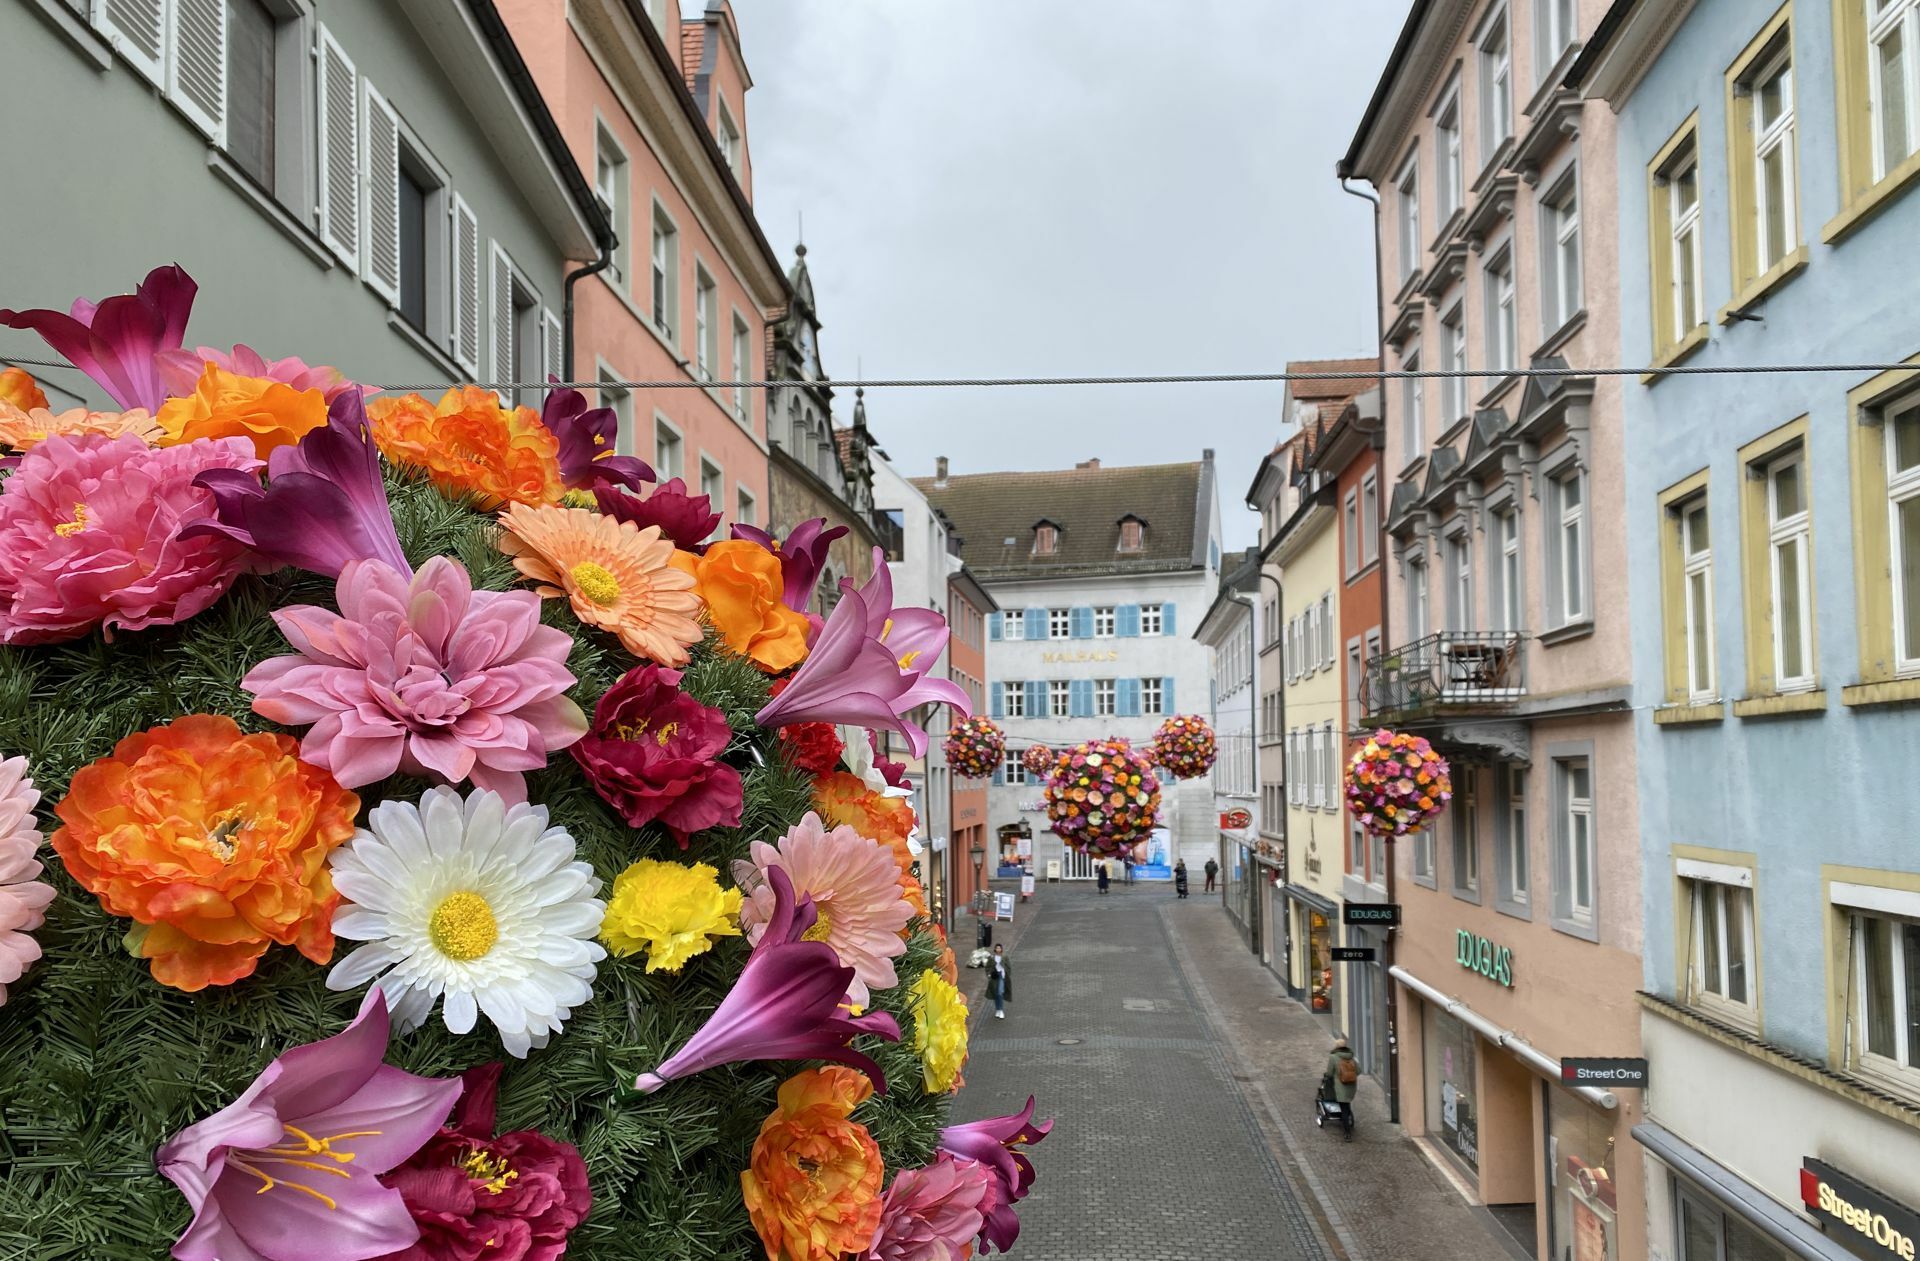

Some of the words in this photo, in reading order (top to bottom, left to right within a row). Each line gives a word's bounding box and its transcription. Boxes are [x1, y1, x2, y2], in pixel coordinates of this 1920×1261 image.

[1350, 910, 1392, 919] DOUGLAS
[1456, 928, 1512, 987] DOUGLAS
[1577, 1067, 1615, 1079] Street
[1616, 1068, 1642, 1080] One
[1818, 1182, 1874, 1238] Street
[1873, 1213, 1915, 1261] One
